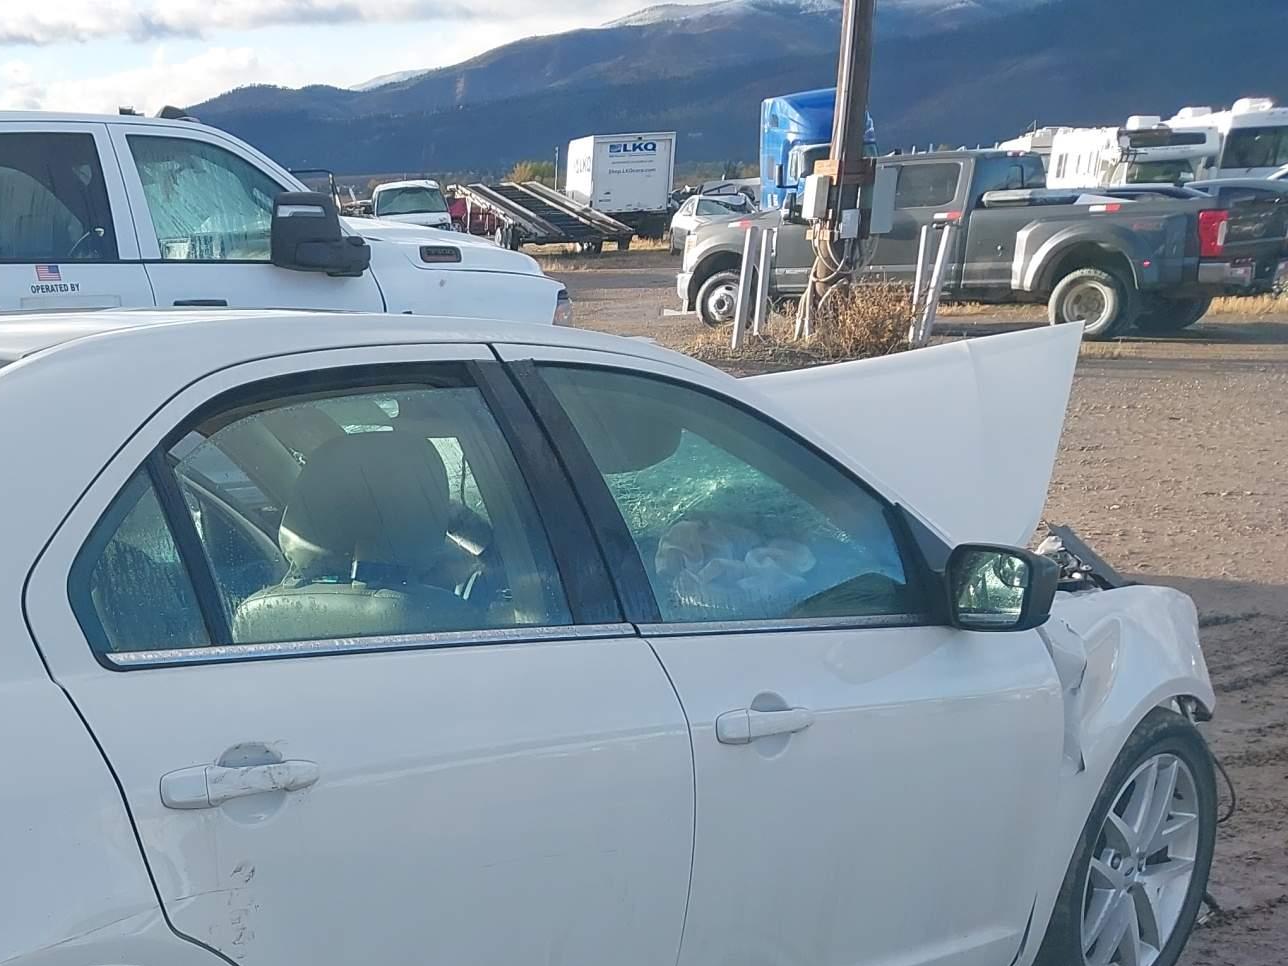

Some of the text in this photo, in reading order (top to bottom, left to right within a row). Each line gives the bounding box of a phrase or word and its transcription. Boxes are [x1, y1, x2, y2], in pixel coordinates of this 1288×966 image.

[623, 142, 657, 152] LKQ
[30, 283, 80, 294] OPERATED BY
